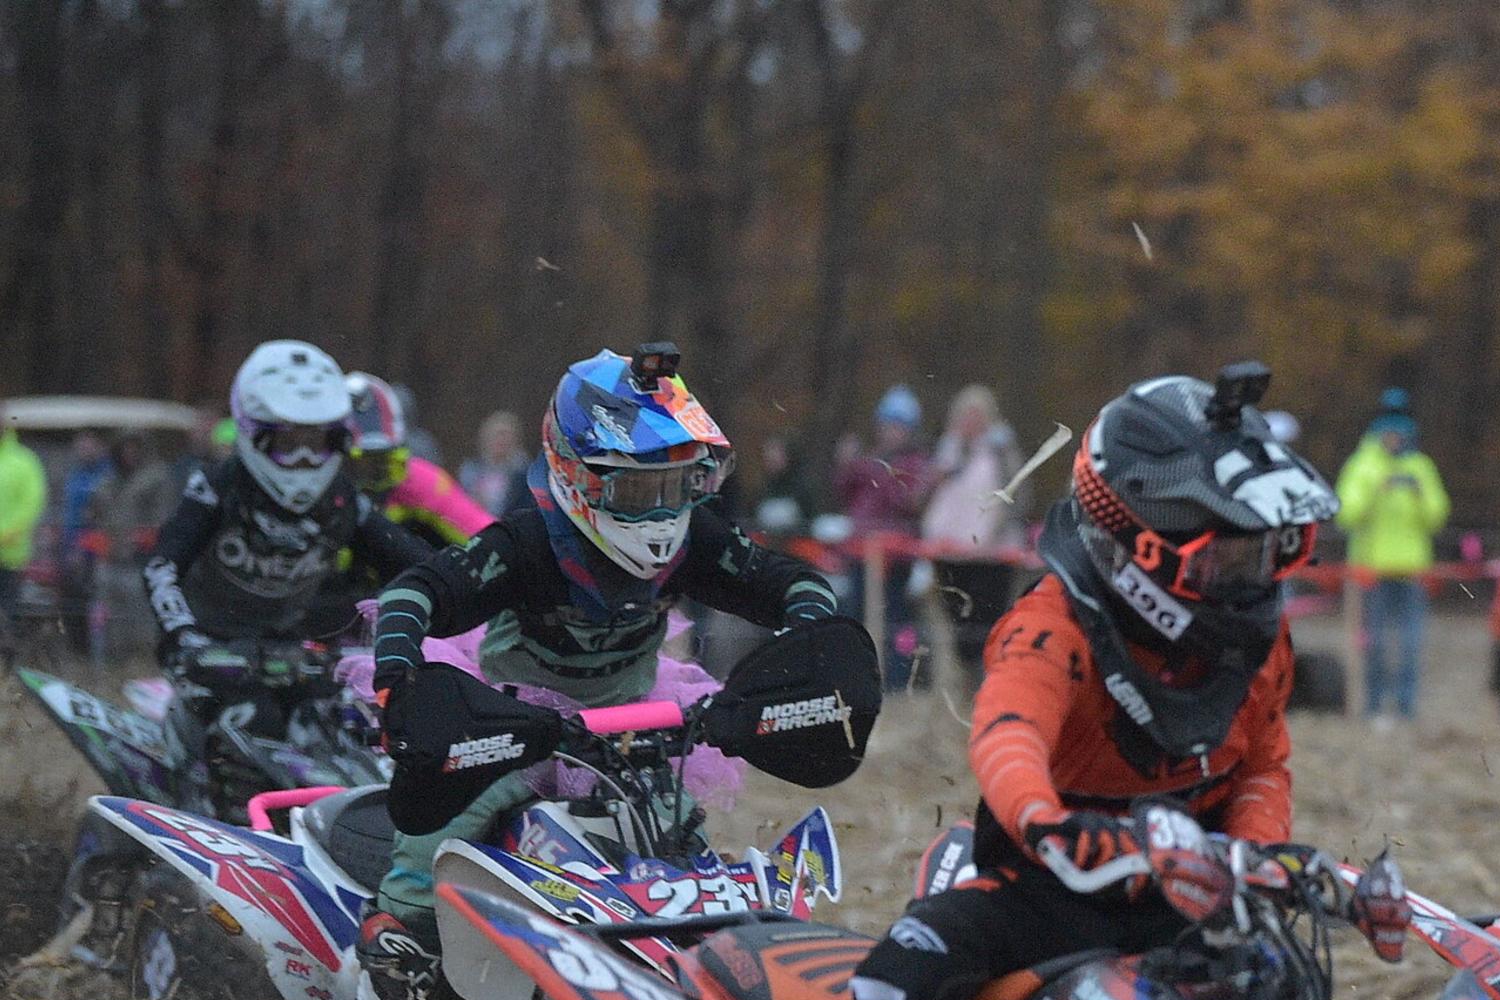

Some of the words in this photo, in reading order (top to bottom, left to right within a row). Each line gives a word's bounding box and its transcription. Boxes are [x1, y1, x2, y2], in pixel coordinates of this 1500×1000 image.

[760, 695, 837, 721] MOOSE
[771, 706, 853, 732] RACING
[448, 732, 515, 759] MOOSE
[456, 742, 527, 770] RACING
[285, 957, 313, 977] RK
